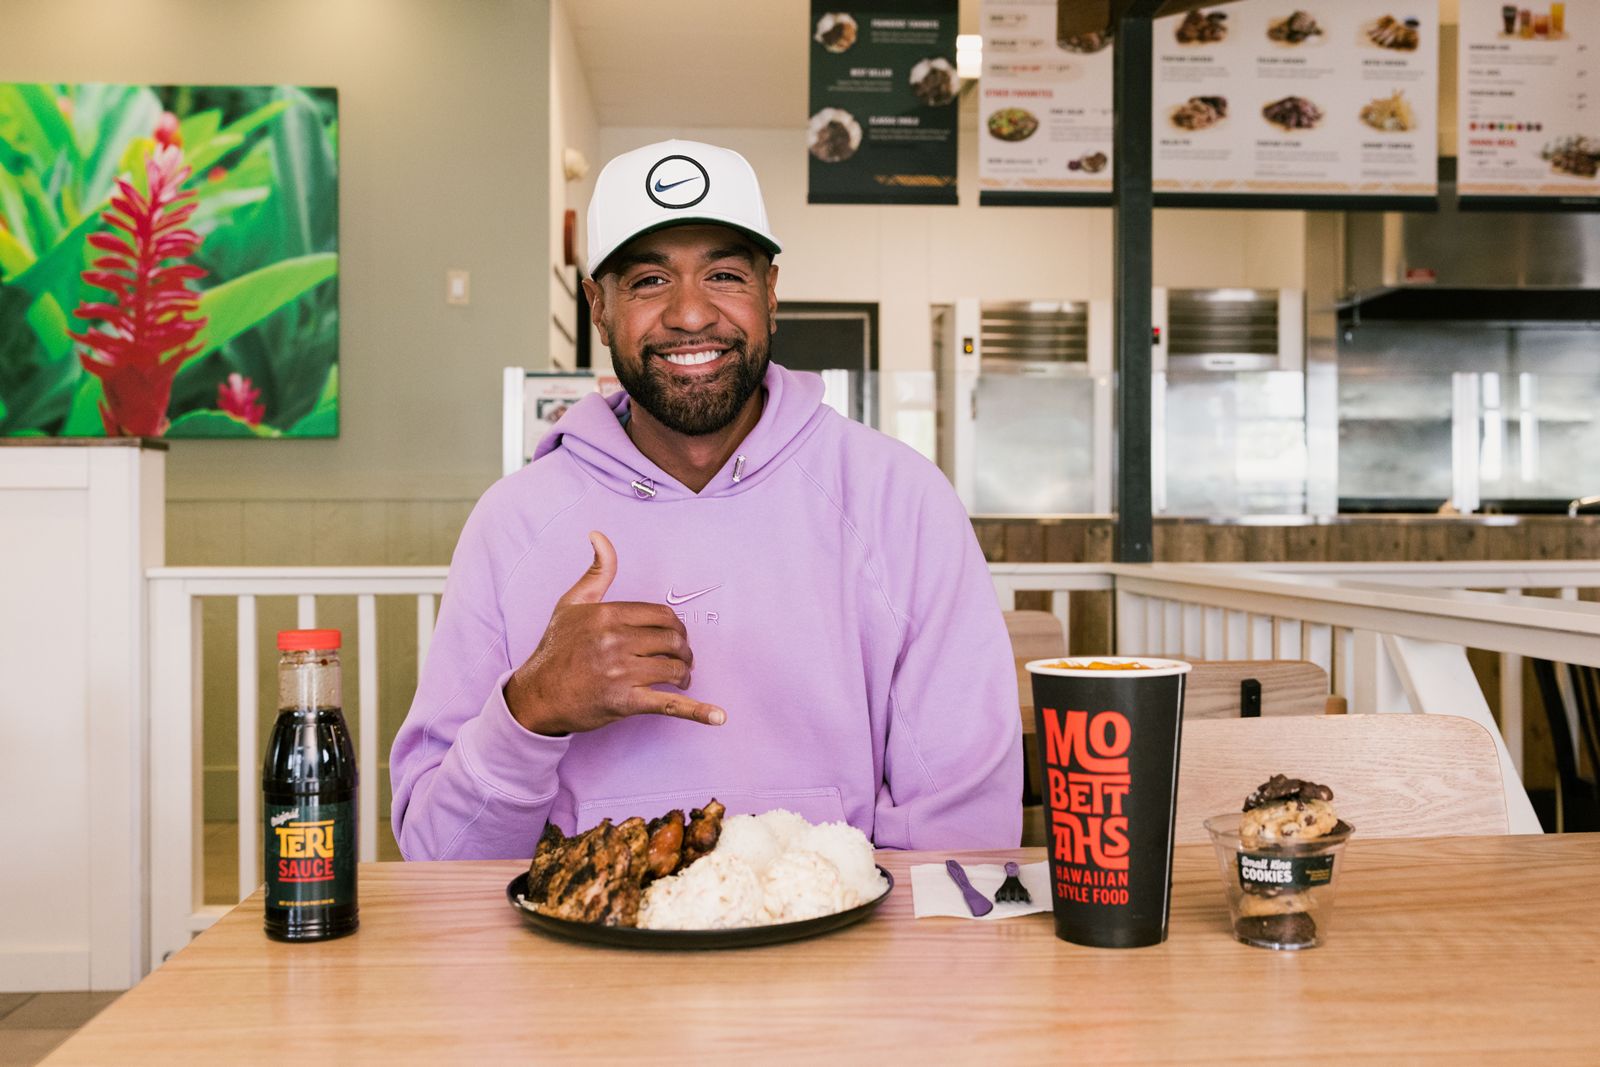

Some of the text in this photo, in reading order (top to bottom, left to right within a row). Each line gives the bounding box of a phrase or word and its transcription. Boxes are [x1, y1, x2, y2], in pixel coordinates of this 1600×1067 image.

[1042, 707, 1132, 774] MO
[275, 820, 335, 859] TERI
[278, 858, 335, 878] SAUCE
[1241, 856, 1268, 870] Small
[1055, 865, 1129, 888] HAWAIIAN
[1242, 867, 1293, 884] COOKIES
[1057, 884, 1129, 906] STYLE FOOD
